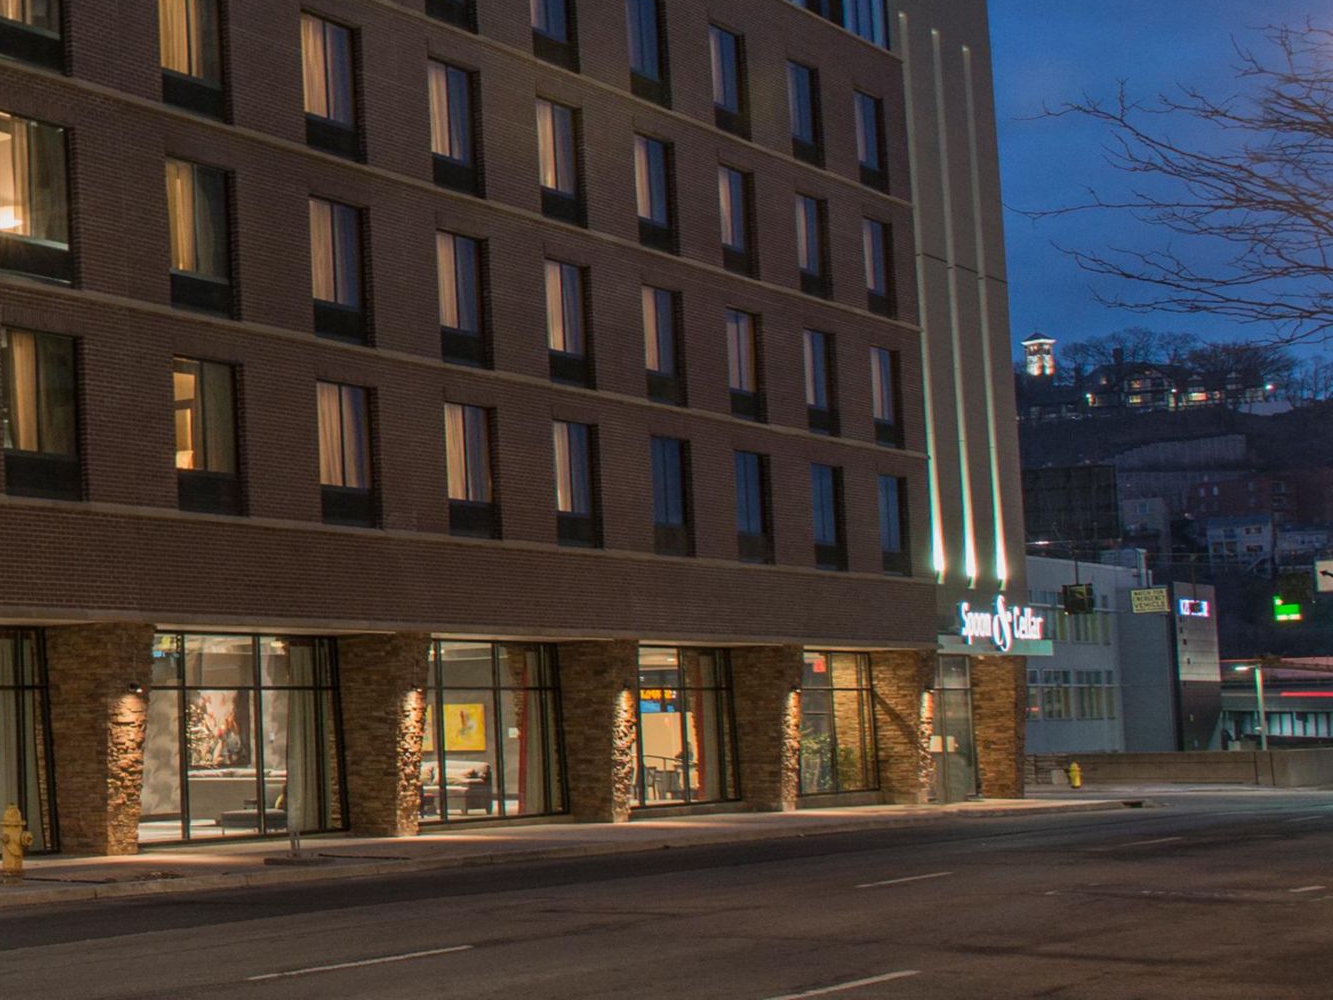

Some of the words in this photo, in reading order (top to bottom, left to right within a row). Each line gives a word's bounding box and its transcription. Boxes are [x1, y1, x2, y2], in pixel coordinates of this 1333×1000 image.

[961, 601, 993, 646] Spoon
[993, 594, 1013, 653] &
[1013, 605, 1044, 640] Cellar
